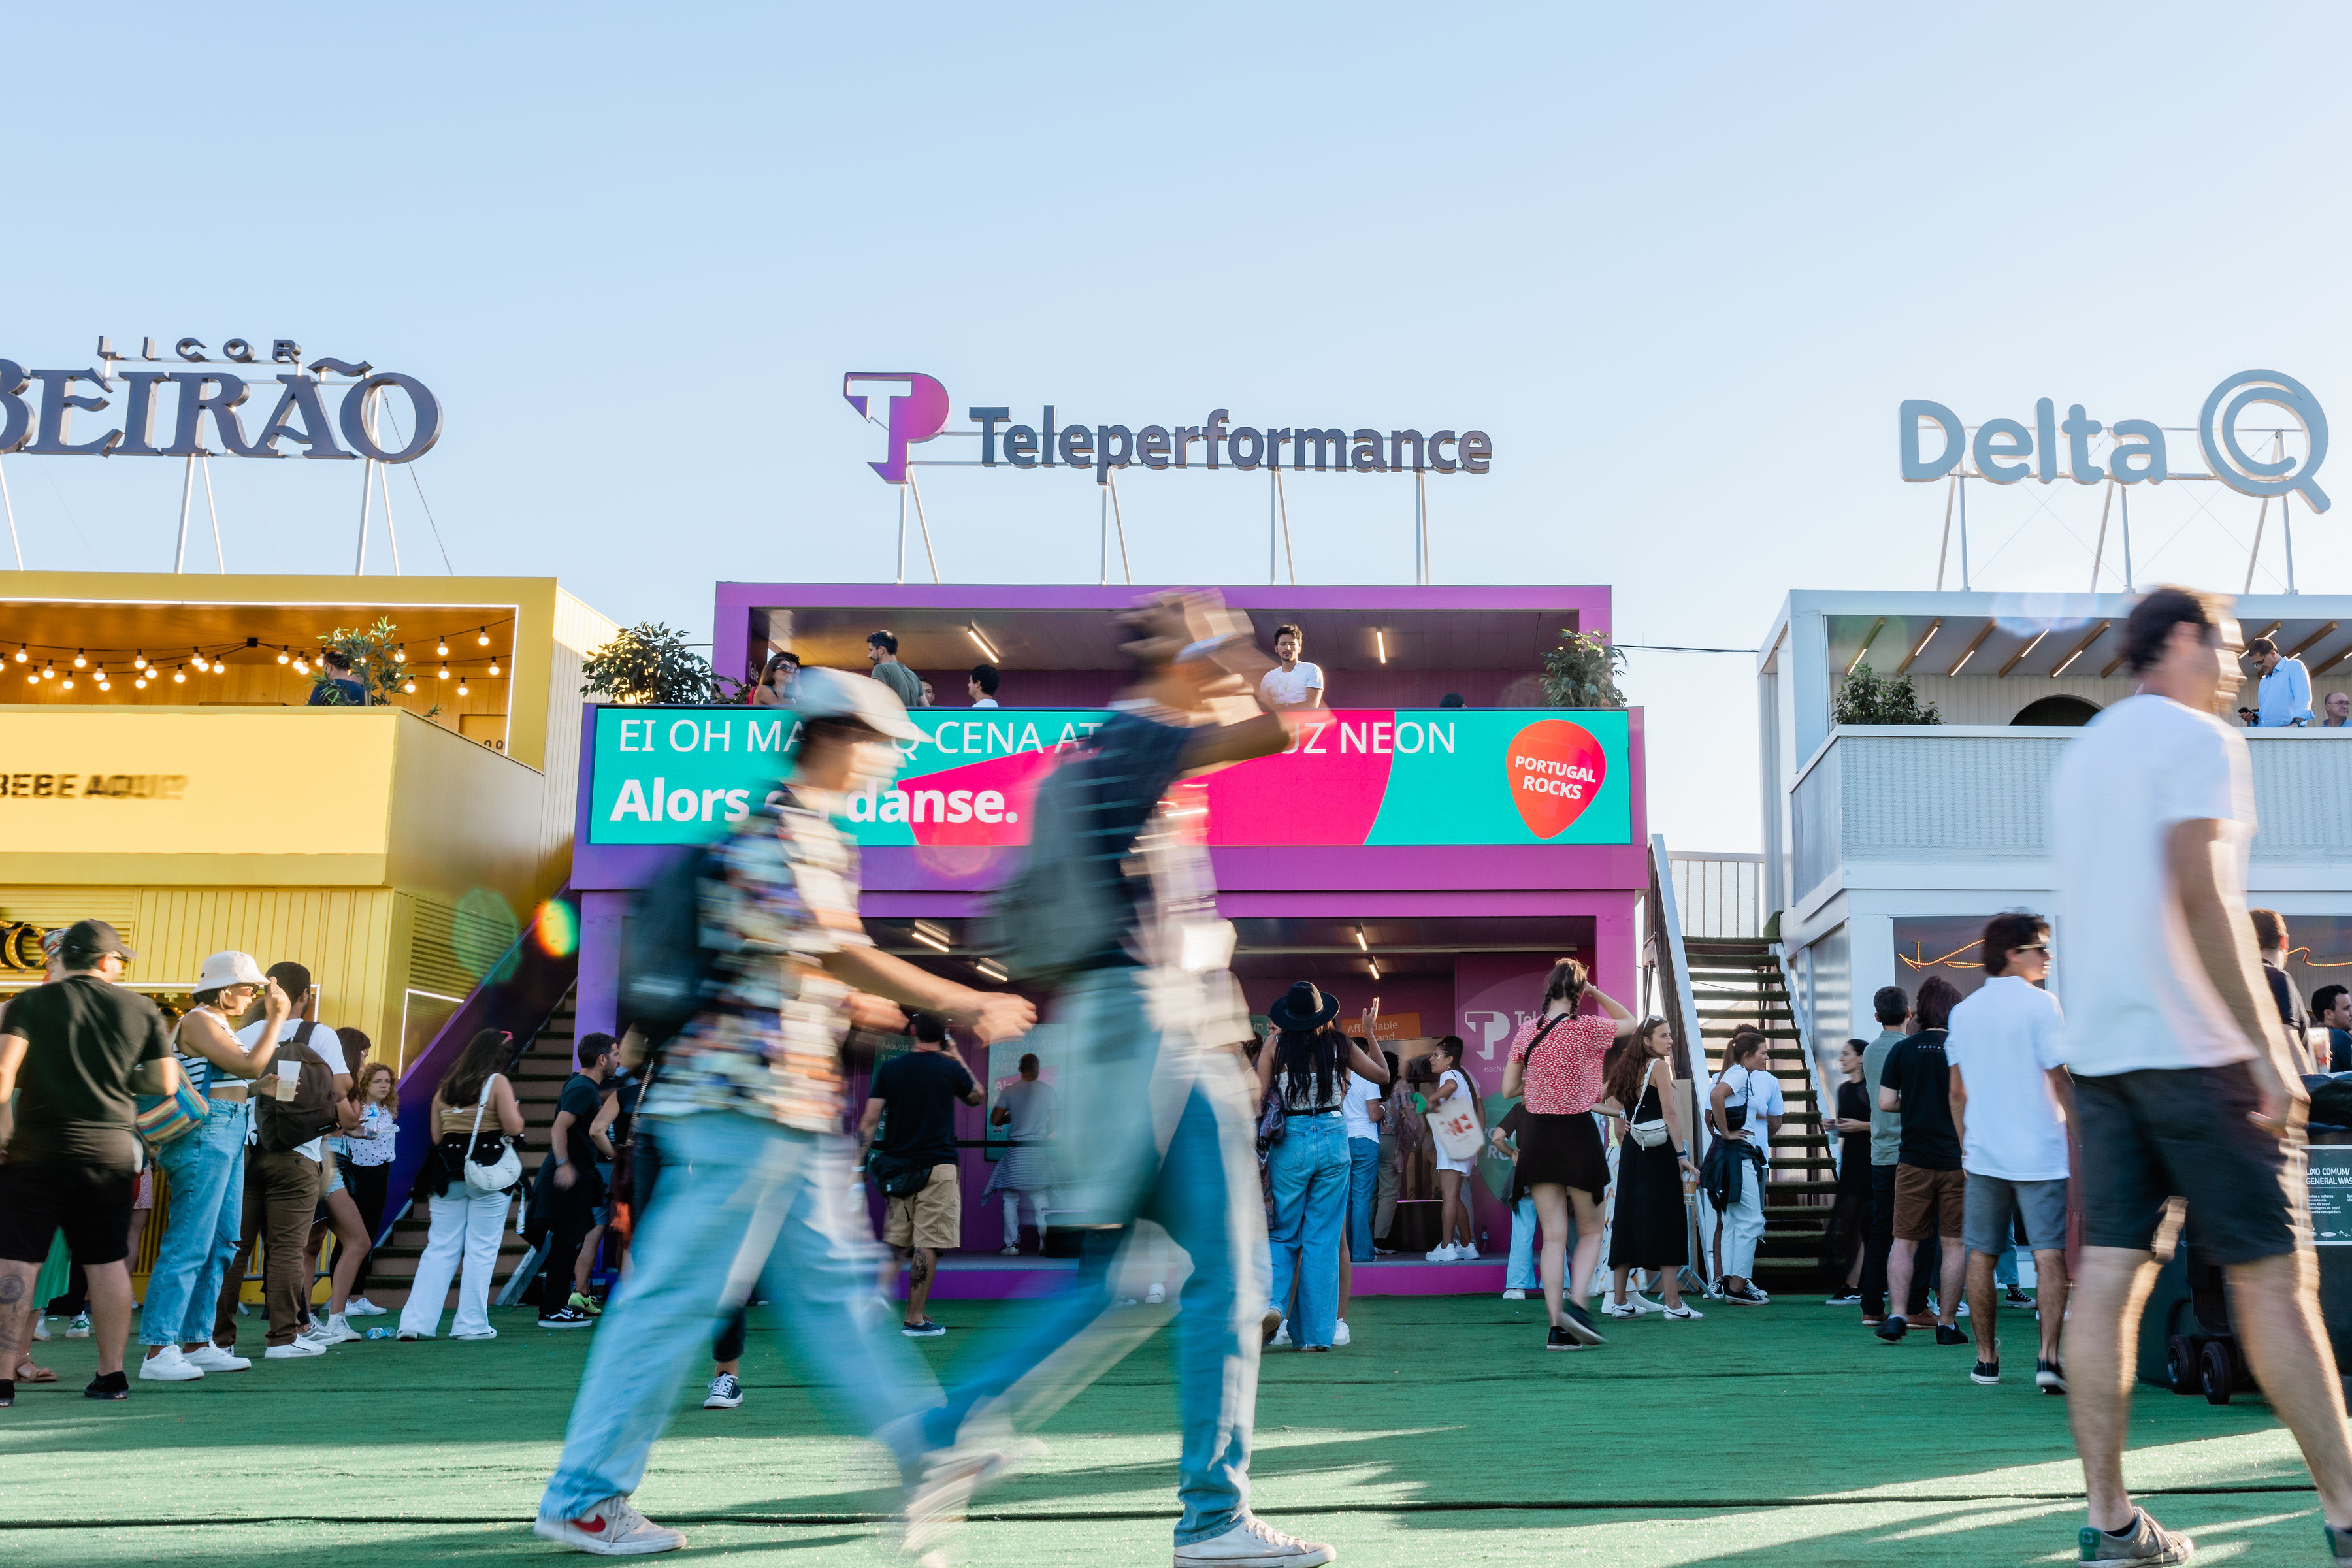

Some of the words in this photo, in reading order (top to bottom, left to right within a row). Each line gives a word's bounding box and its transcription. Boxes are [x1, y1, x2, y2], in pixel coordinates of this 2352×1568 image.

[97, 335, 302, 363] LICOR
[969, 404, 1493, 486] Teleperformance
[1899, 397, 2168, 485] Delta
[2197, 368, 2332, 515] Q
[619, 719, 655, 752] EI
[669, 720, 732, 753] OH
[890, 721, 920, 760] Q
[935, 721, 1044, 754] CENA
[1054, 722, 1104, 754] AT
[1341, 721, 1455, 754] NEON
[1514, 755, 1596, 783] PORTUGAL
[610, 777, 749, 823] Alors
[847, 777, 1018, 823] danse.
[1522, 775, 1582, 800] ROCKS
[882, 1041, 909, 1051] Novos
[2322, 1167, 2350, 1176] COMUM/
